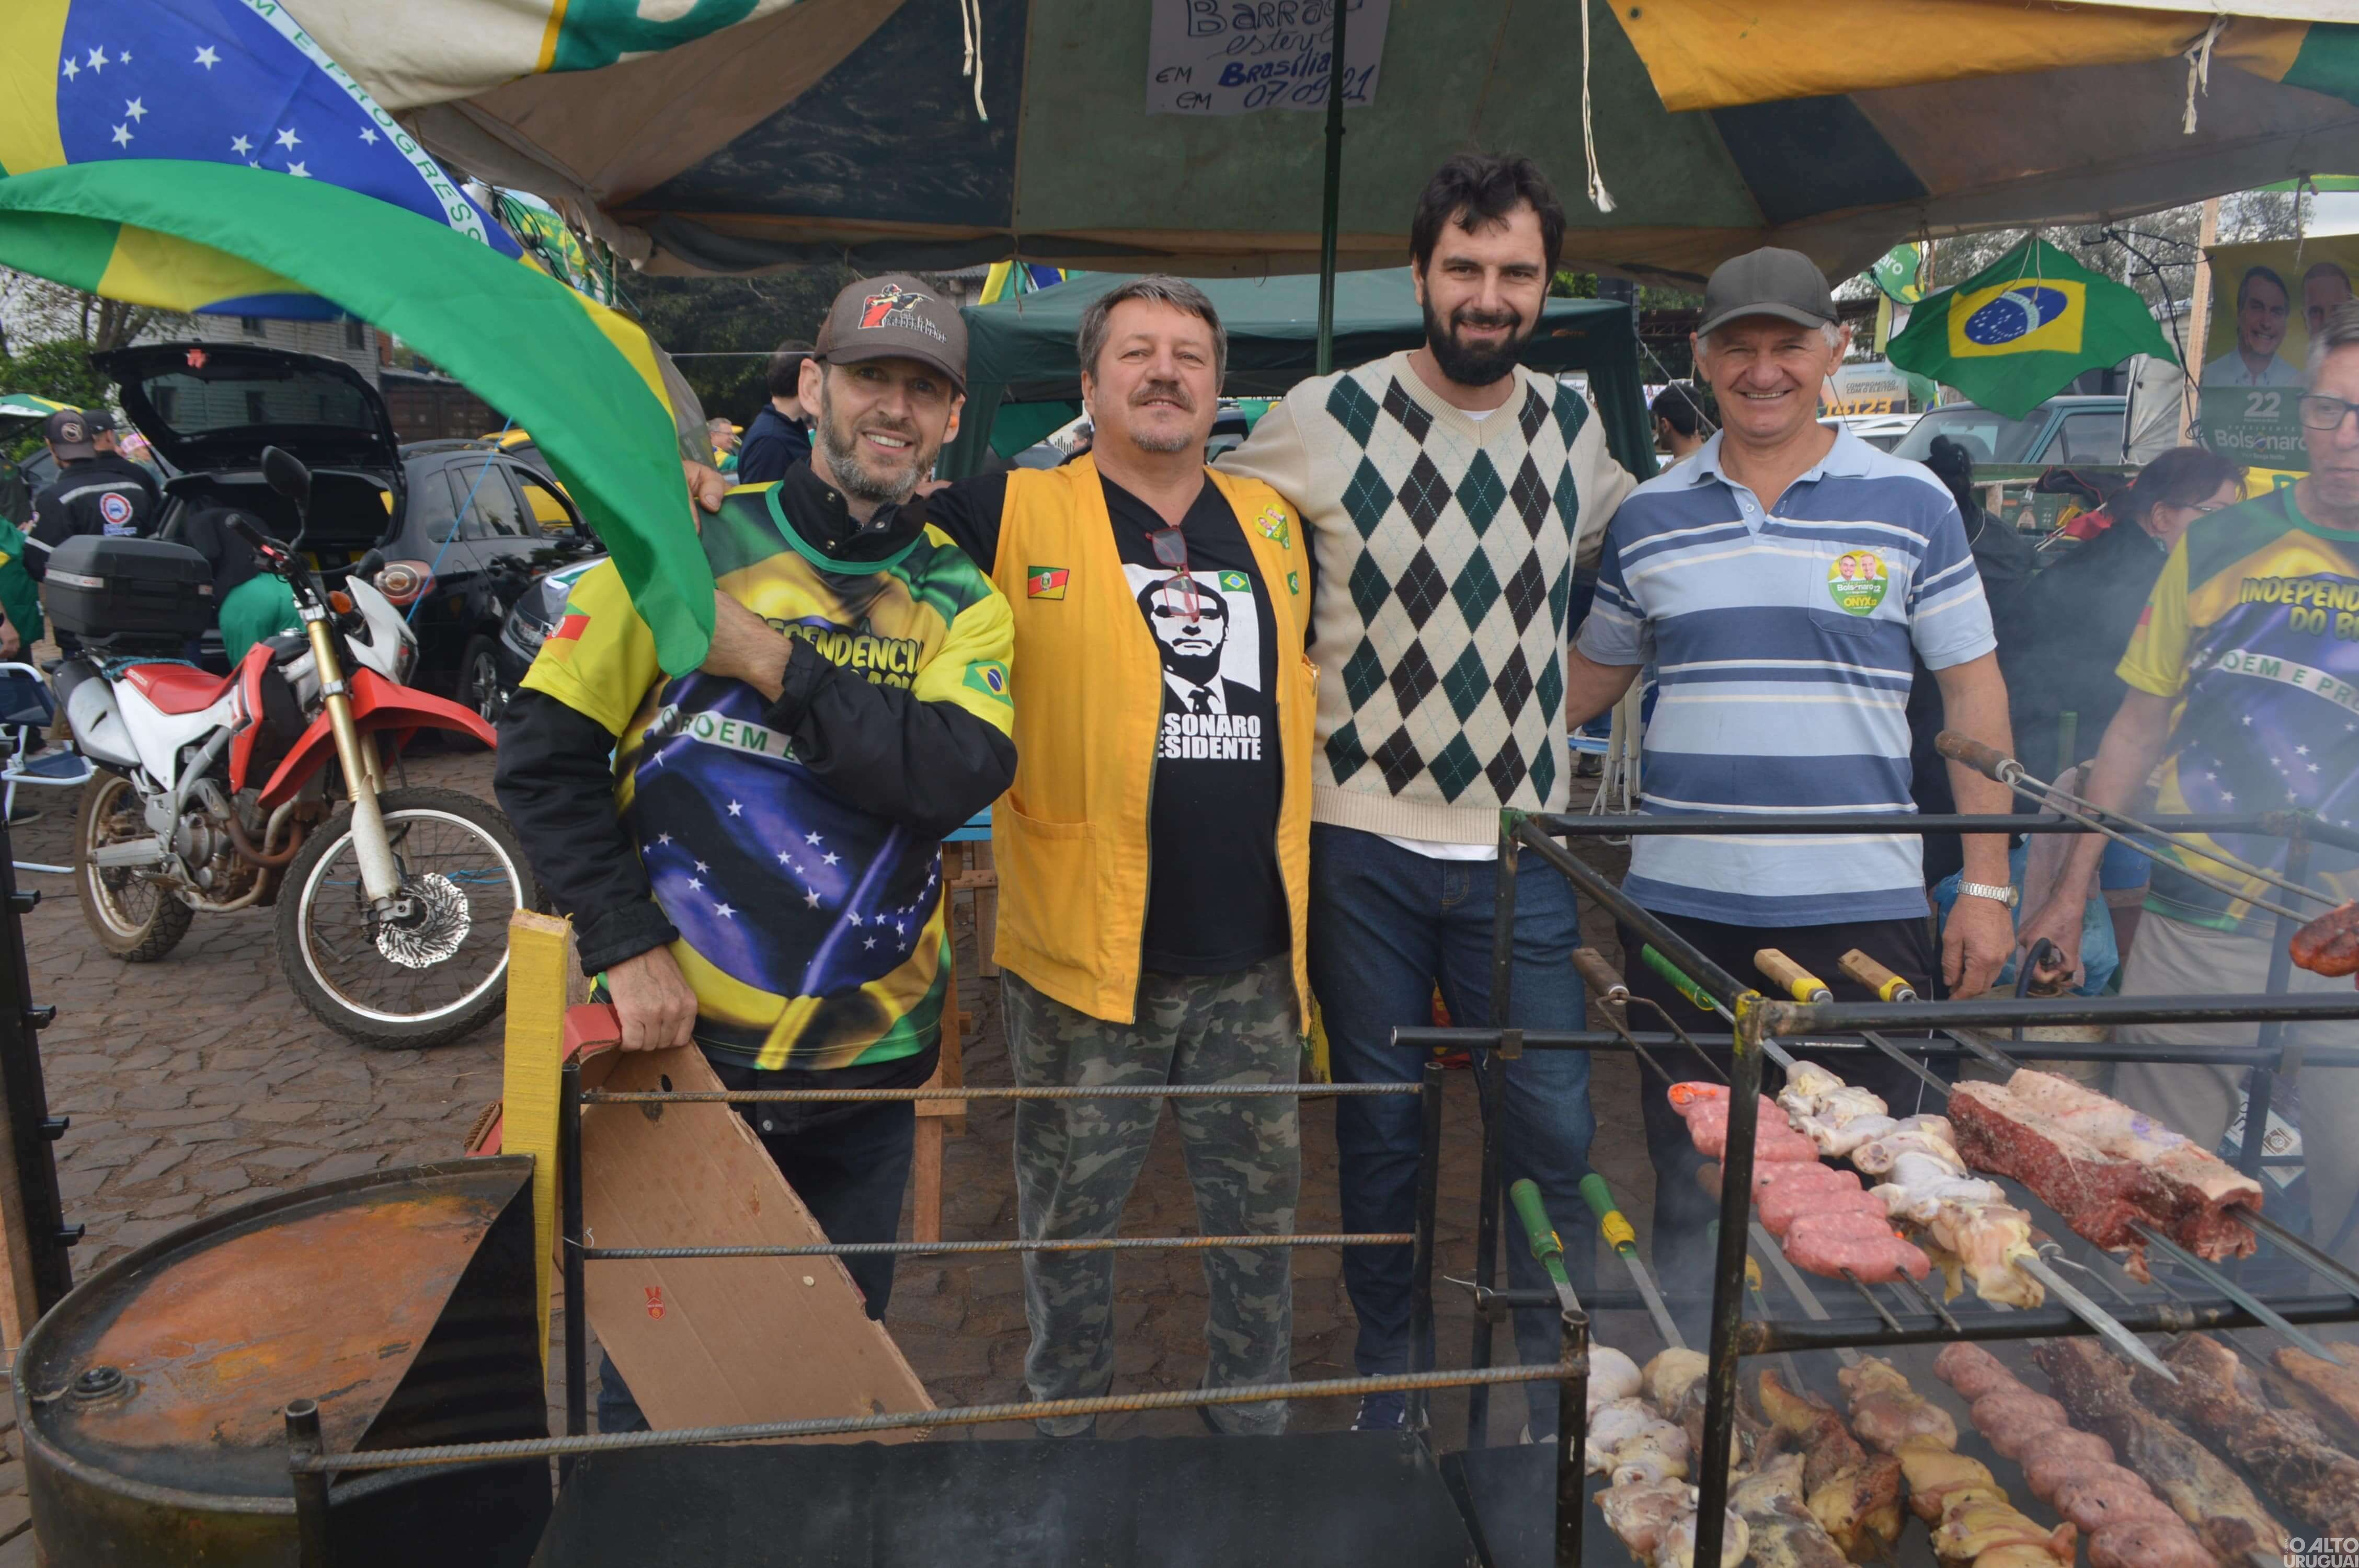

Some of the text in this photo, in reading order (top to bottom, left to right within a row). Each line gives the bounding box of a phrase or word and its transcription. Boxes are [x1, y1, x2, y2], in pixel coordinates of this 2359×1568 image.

[293, 32, 312, 50] E
[1243, 64, 1376, 108] 07/0921
[1846, 380, 1896, 389] COMPROMISSO
[2243, 391, 2281, 418] 22
[1843, 596, 1871, 606] ONYX
[2290, 606, 2327, 635] DO
[2292, 668, 2307, 684] E
[1161, 712, 1261, 737] SONARO
